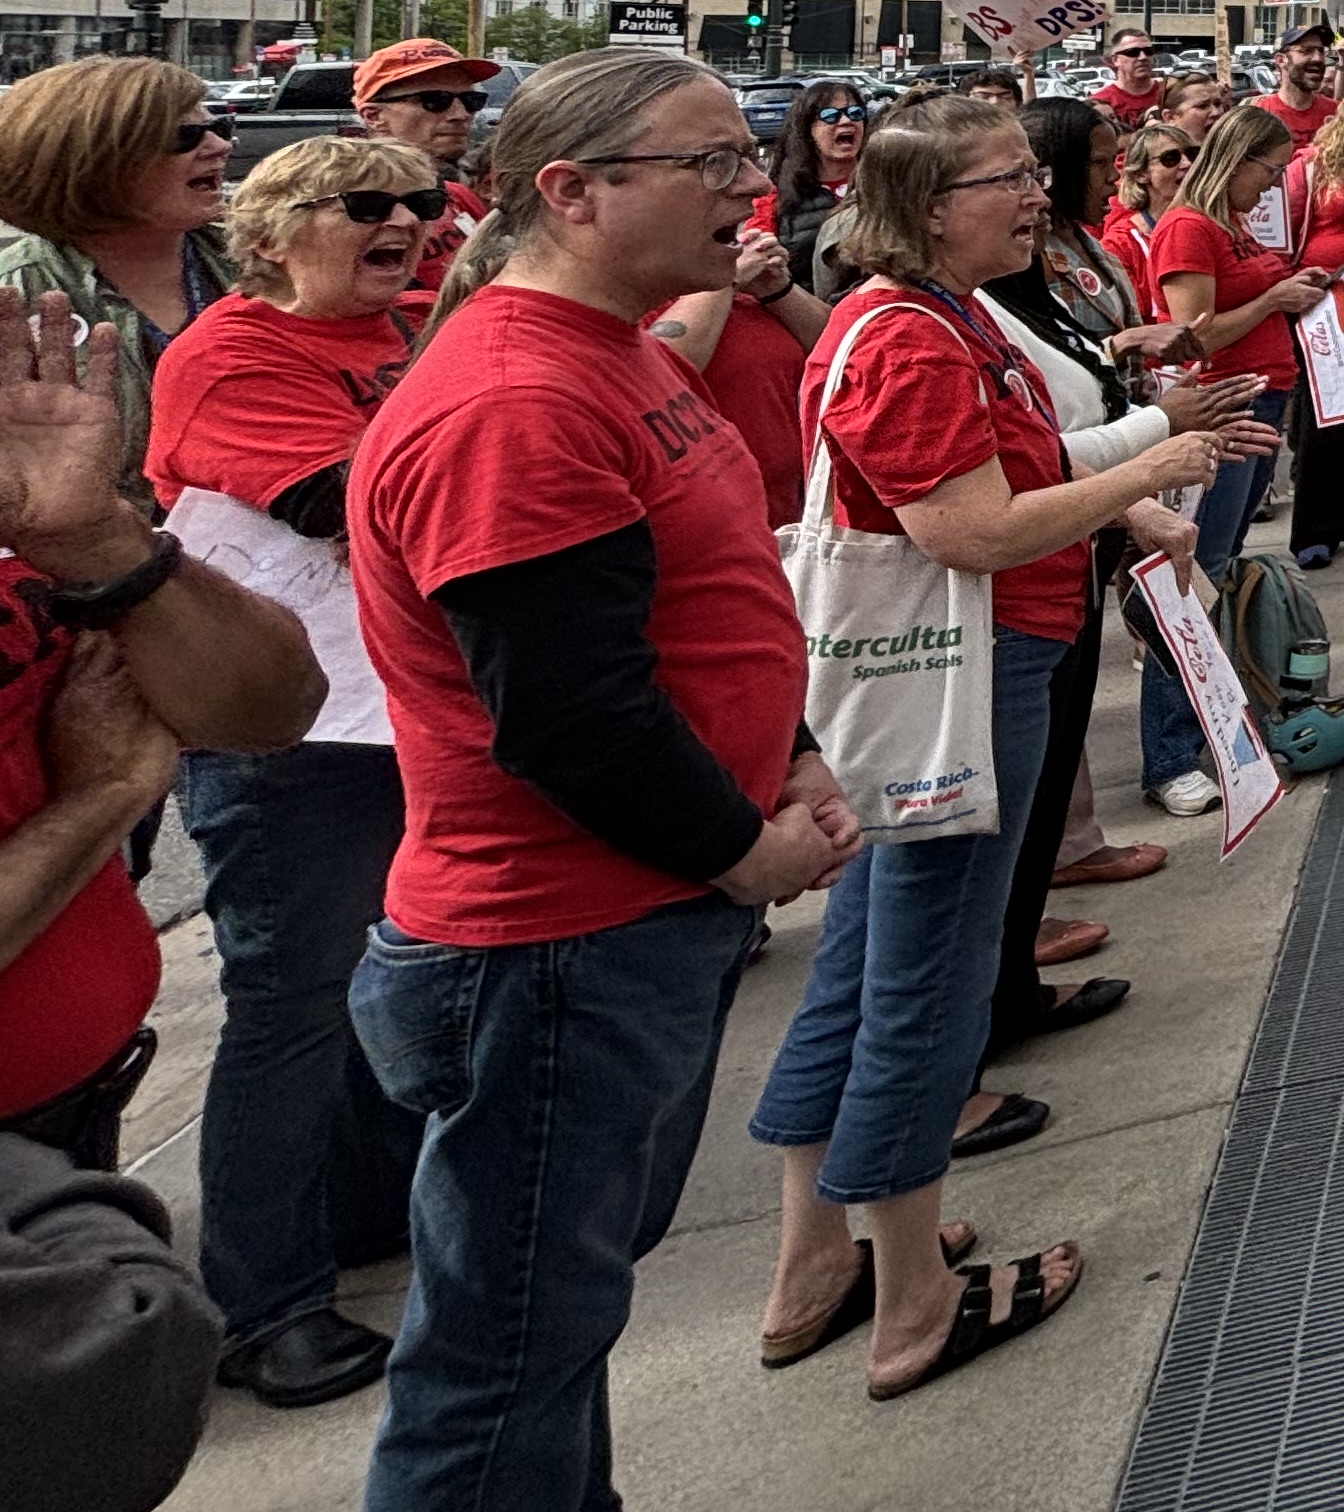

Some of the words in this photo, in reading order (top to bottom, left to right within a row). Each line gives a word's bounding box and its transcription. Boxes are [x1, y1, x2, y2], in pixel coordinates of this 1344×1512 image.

[625, 6, 675, 21] Public
[619, 19, 679, 34] Parking
[1250, 204, 1271, 223] ola
[852, 658, 921, 682] Spanish
[885, 779, 932, 797] Costa
